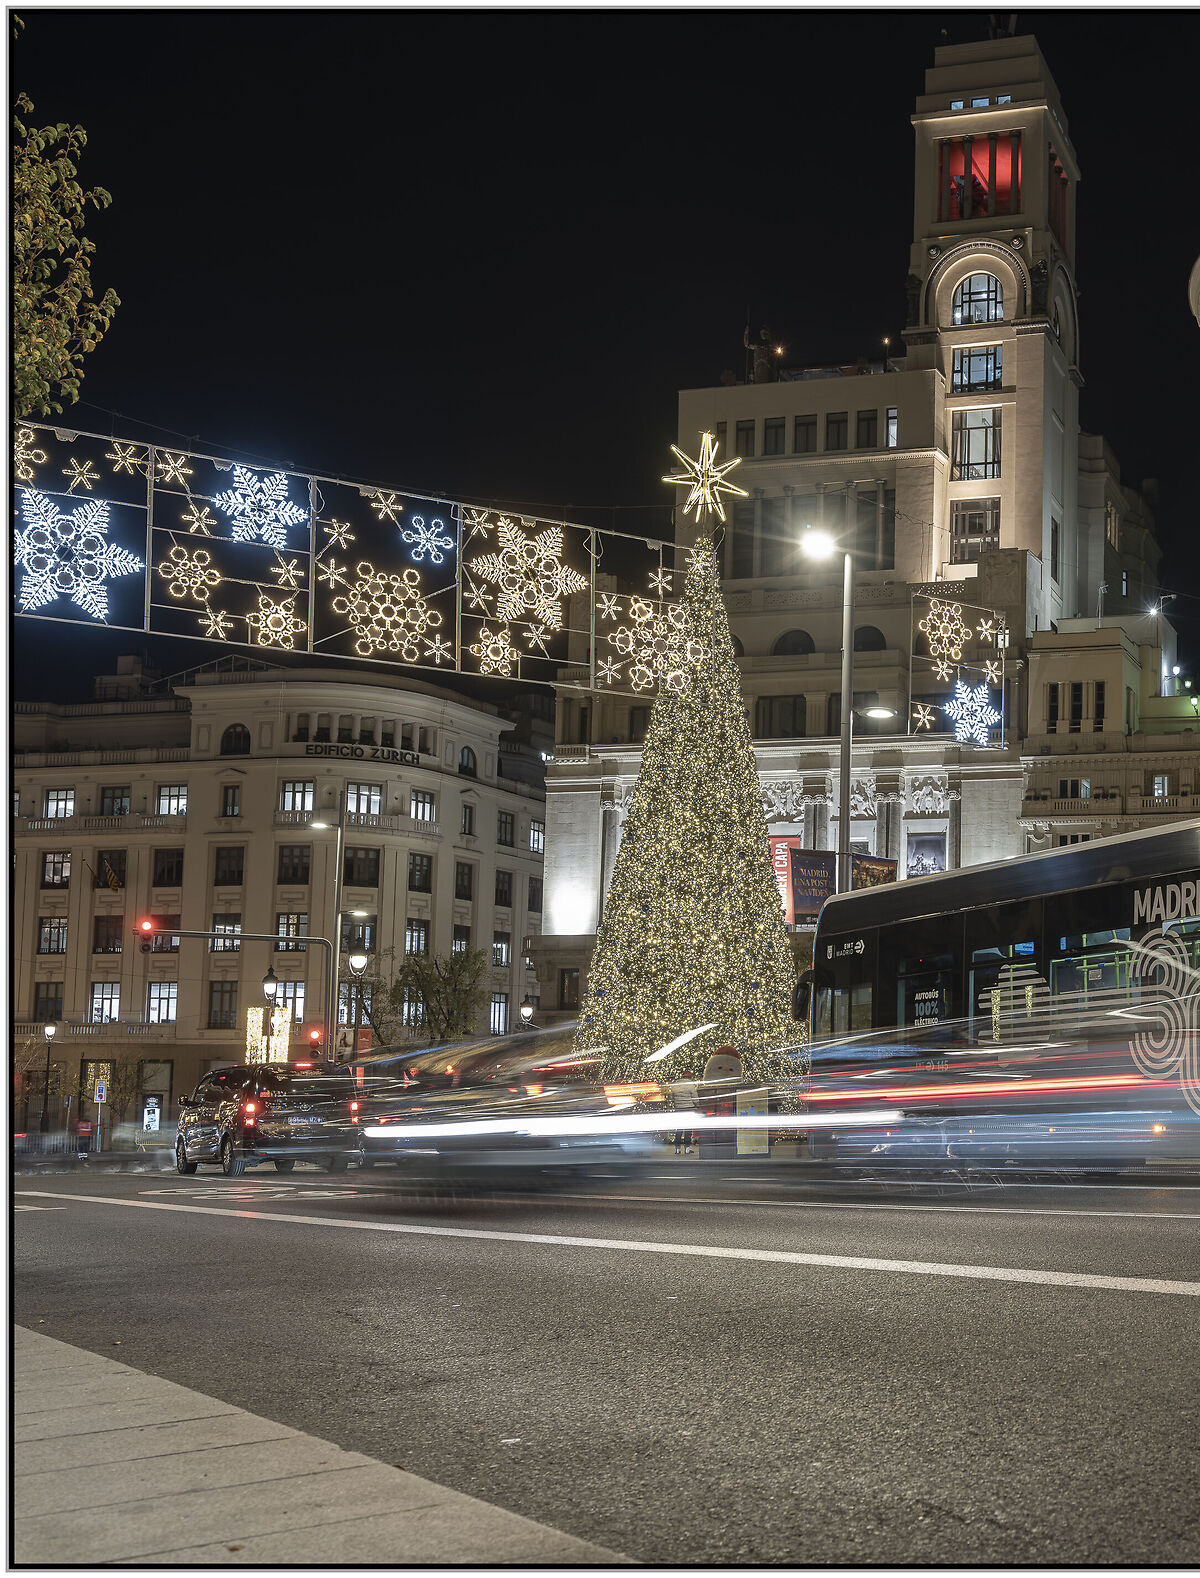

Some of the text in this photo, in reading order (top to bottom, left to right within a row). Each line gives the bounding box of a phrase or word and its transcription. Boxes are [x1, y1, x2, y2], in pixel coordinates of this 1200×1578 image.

[306, 744, 420, 765] EDIFICIO ZURICH
[775, 842, 788, 867] CAPA
[914, 989, 939, 1001] AUTOBÚS
[914, 1001, 939, 1017] 100%
[914, 1016, 939, 1026] ELÉCTRICO
